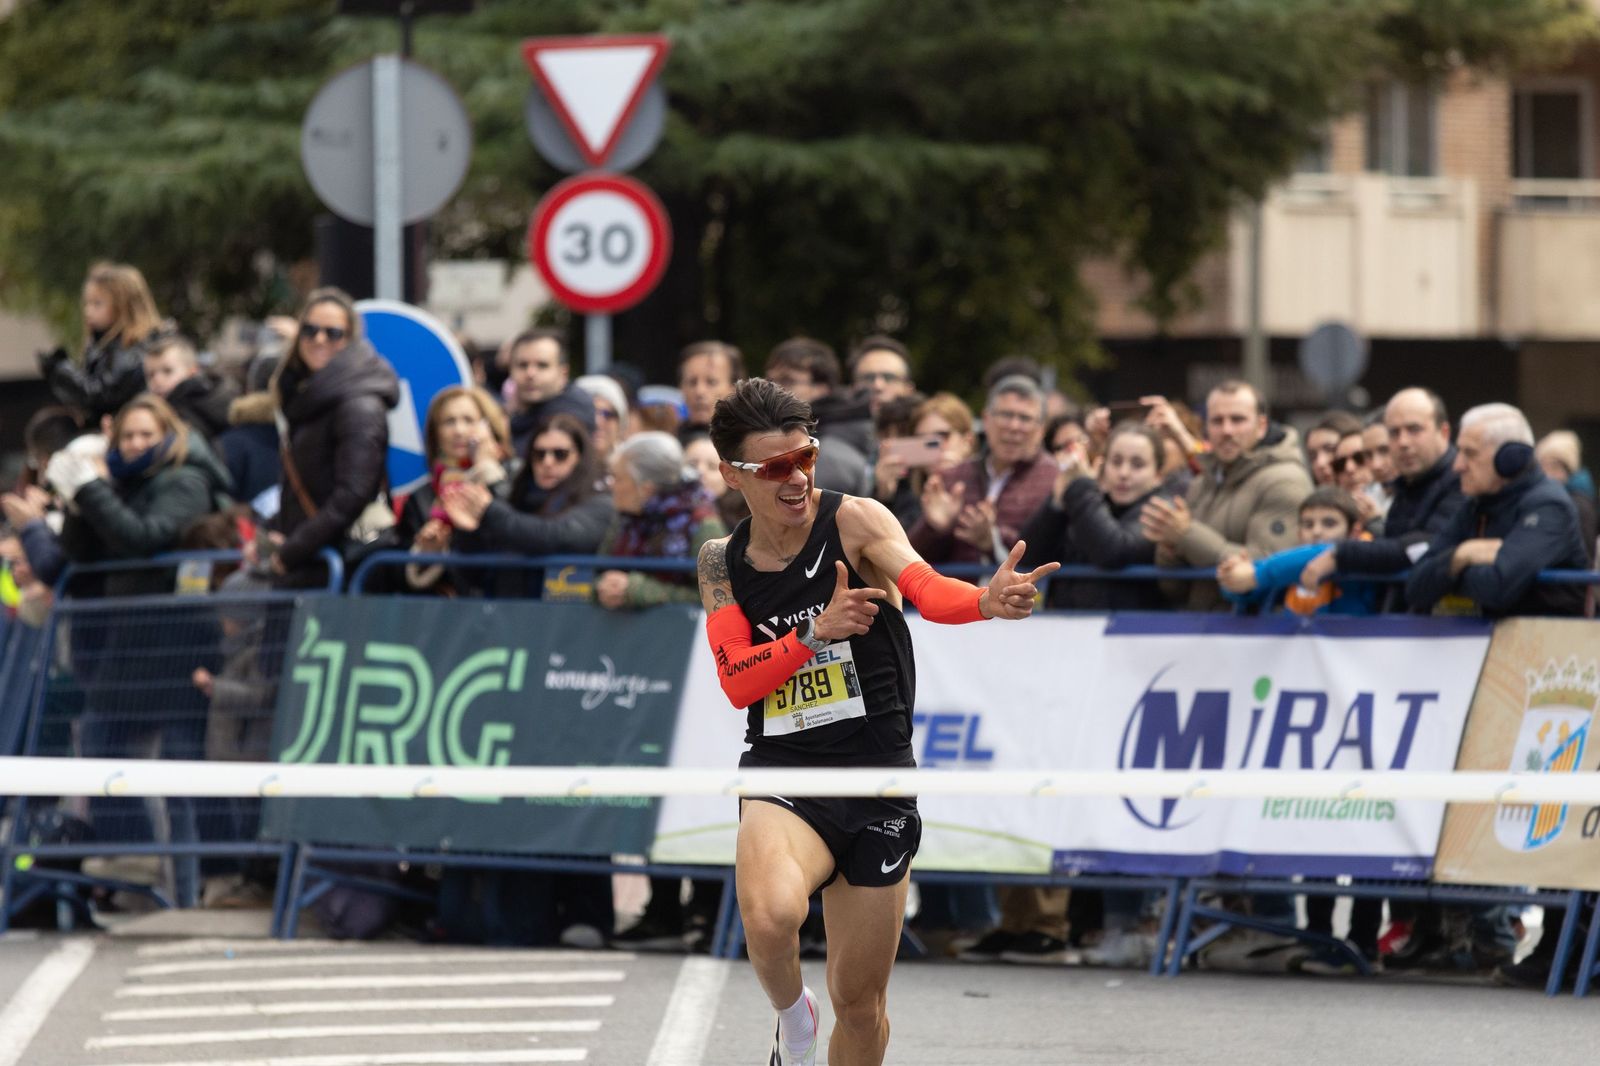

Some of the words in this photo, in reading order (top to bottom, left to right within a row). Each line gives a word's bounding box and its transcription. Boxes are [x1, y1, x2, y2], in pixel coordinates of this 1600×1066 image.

[563, 223, 634, 265] 30
[784, 603, 825, 627] VICKY
[775, 668, 833, 709] 5789
